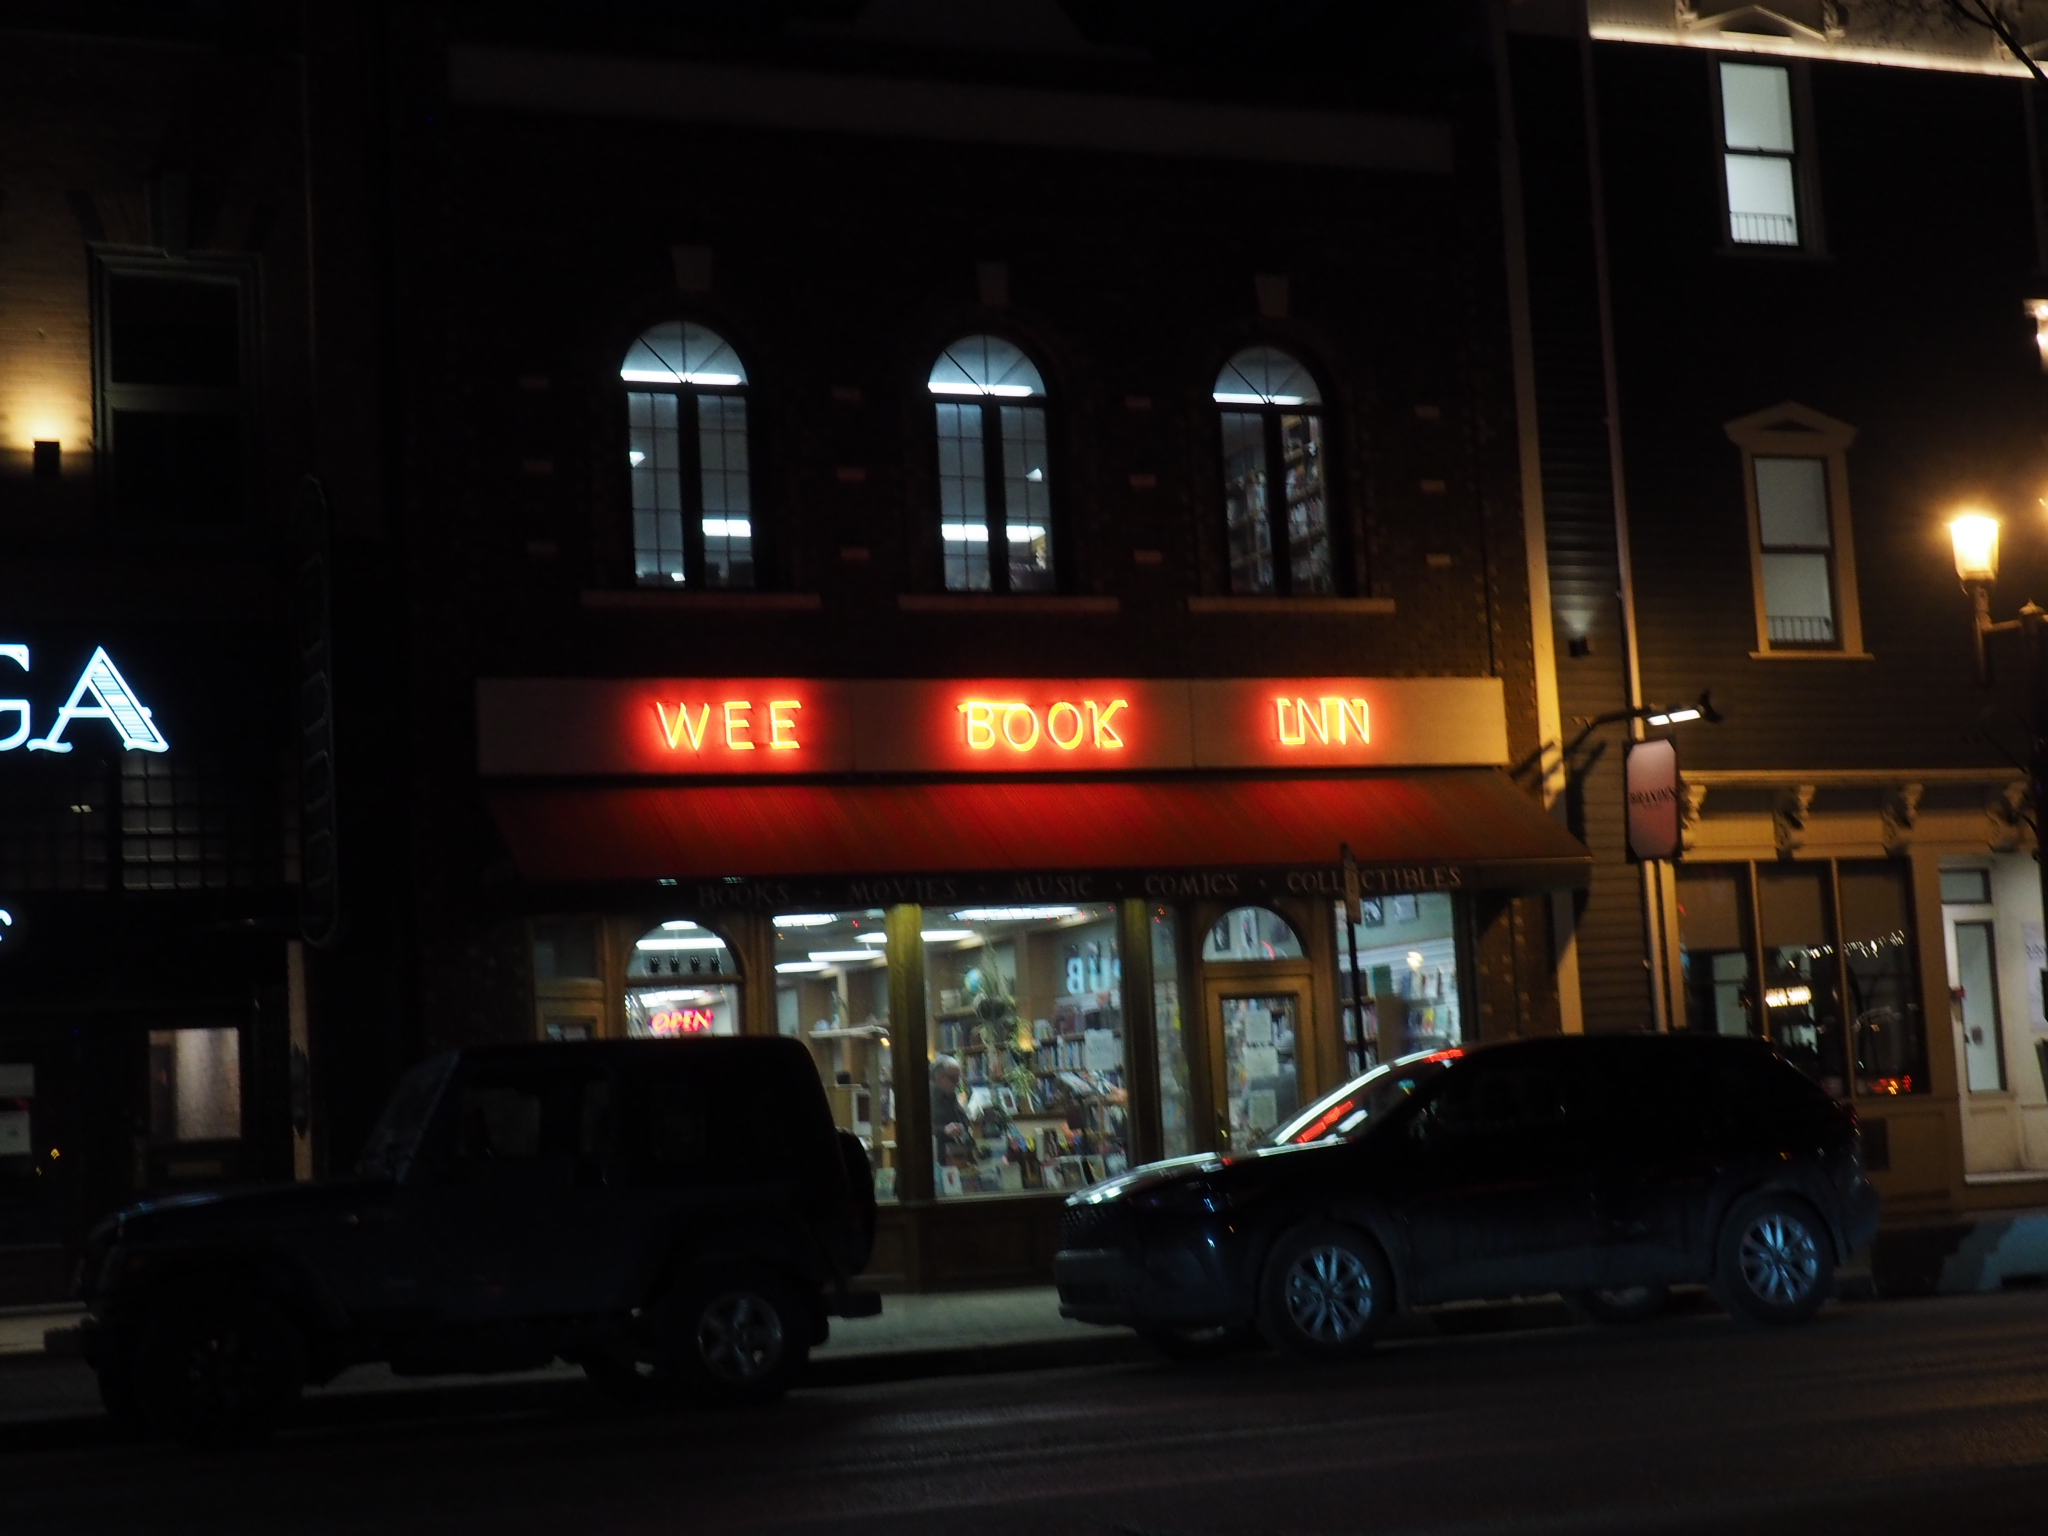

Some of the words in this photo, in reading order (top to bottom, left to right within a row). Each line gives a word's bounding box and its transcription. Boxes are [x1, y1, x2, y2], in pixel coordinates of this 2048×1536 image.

[655, 699, 804, 753] WEE
[957, 697, 1129, 754] BOOK
[1275, 696, 1374, 748] INN
[696, 882, 791, 909] BOOKS
[847, 877, 958, 903] MOVIES
[1012, 874, 1093, 901] MUSIC
[1144, 873, 1240, 896] COMICS
[1286, 866, 1463, 895] COLLCTIBLES
[650, 1008, 715, 1034] OPEN
